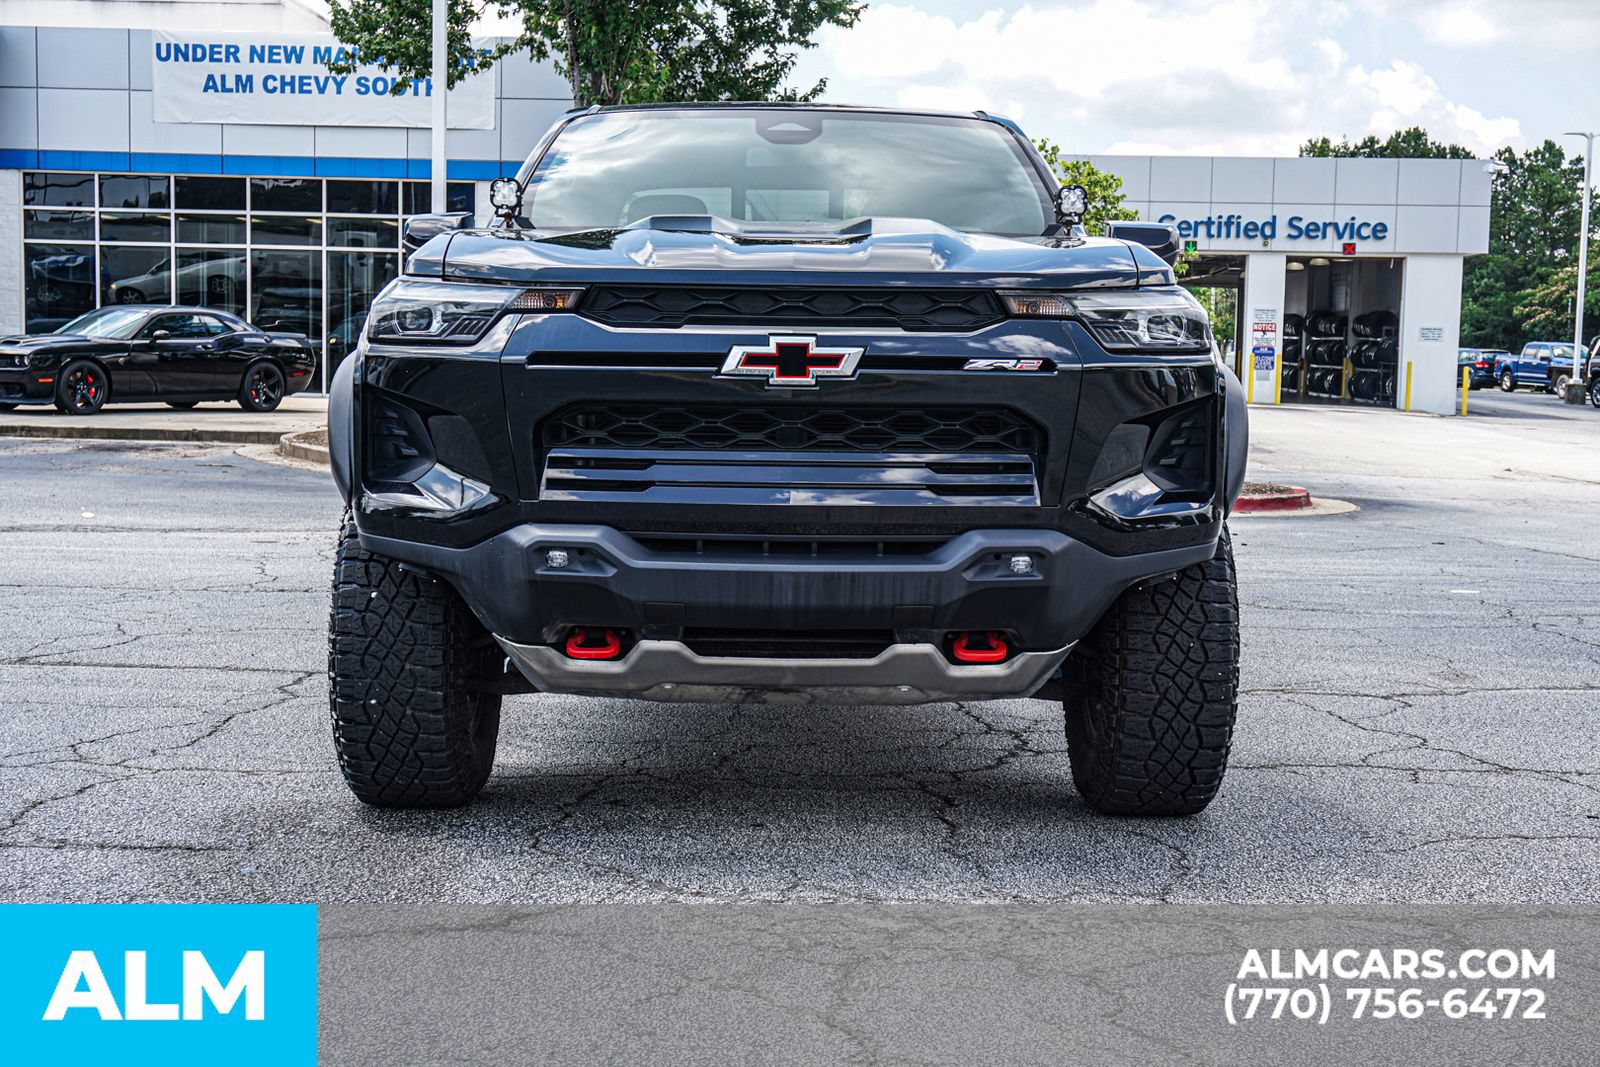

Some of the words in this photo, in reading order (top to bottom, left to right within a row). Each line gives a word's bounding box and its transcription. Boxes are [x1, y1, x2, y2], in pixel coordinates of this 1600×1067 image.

[155, 42, 241, 64] UNDER
[248, 44, 305, 65] NEW
[202, 73, 254, 94] ALM
[262, 74, 348, 96] CHEVY
[1286, 215, 1388, 241] Service
[1253, 323, 1276, 331] NOTICE
[962, 358, 1043, 371] ZR2
